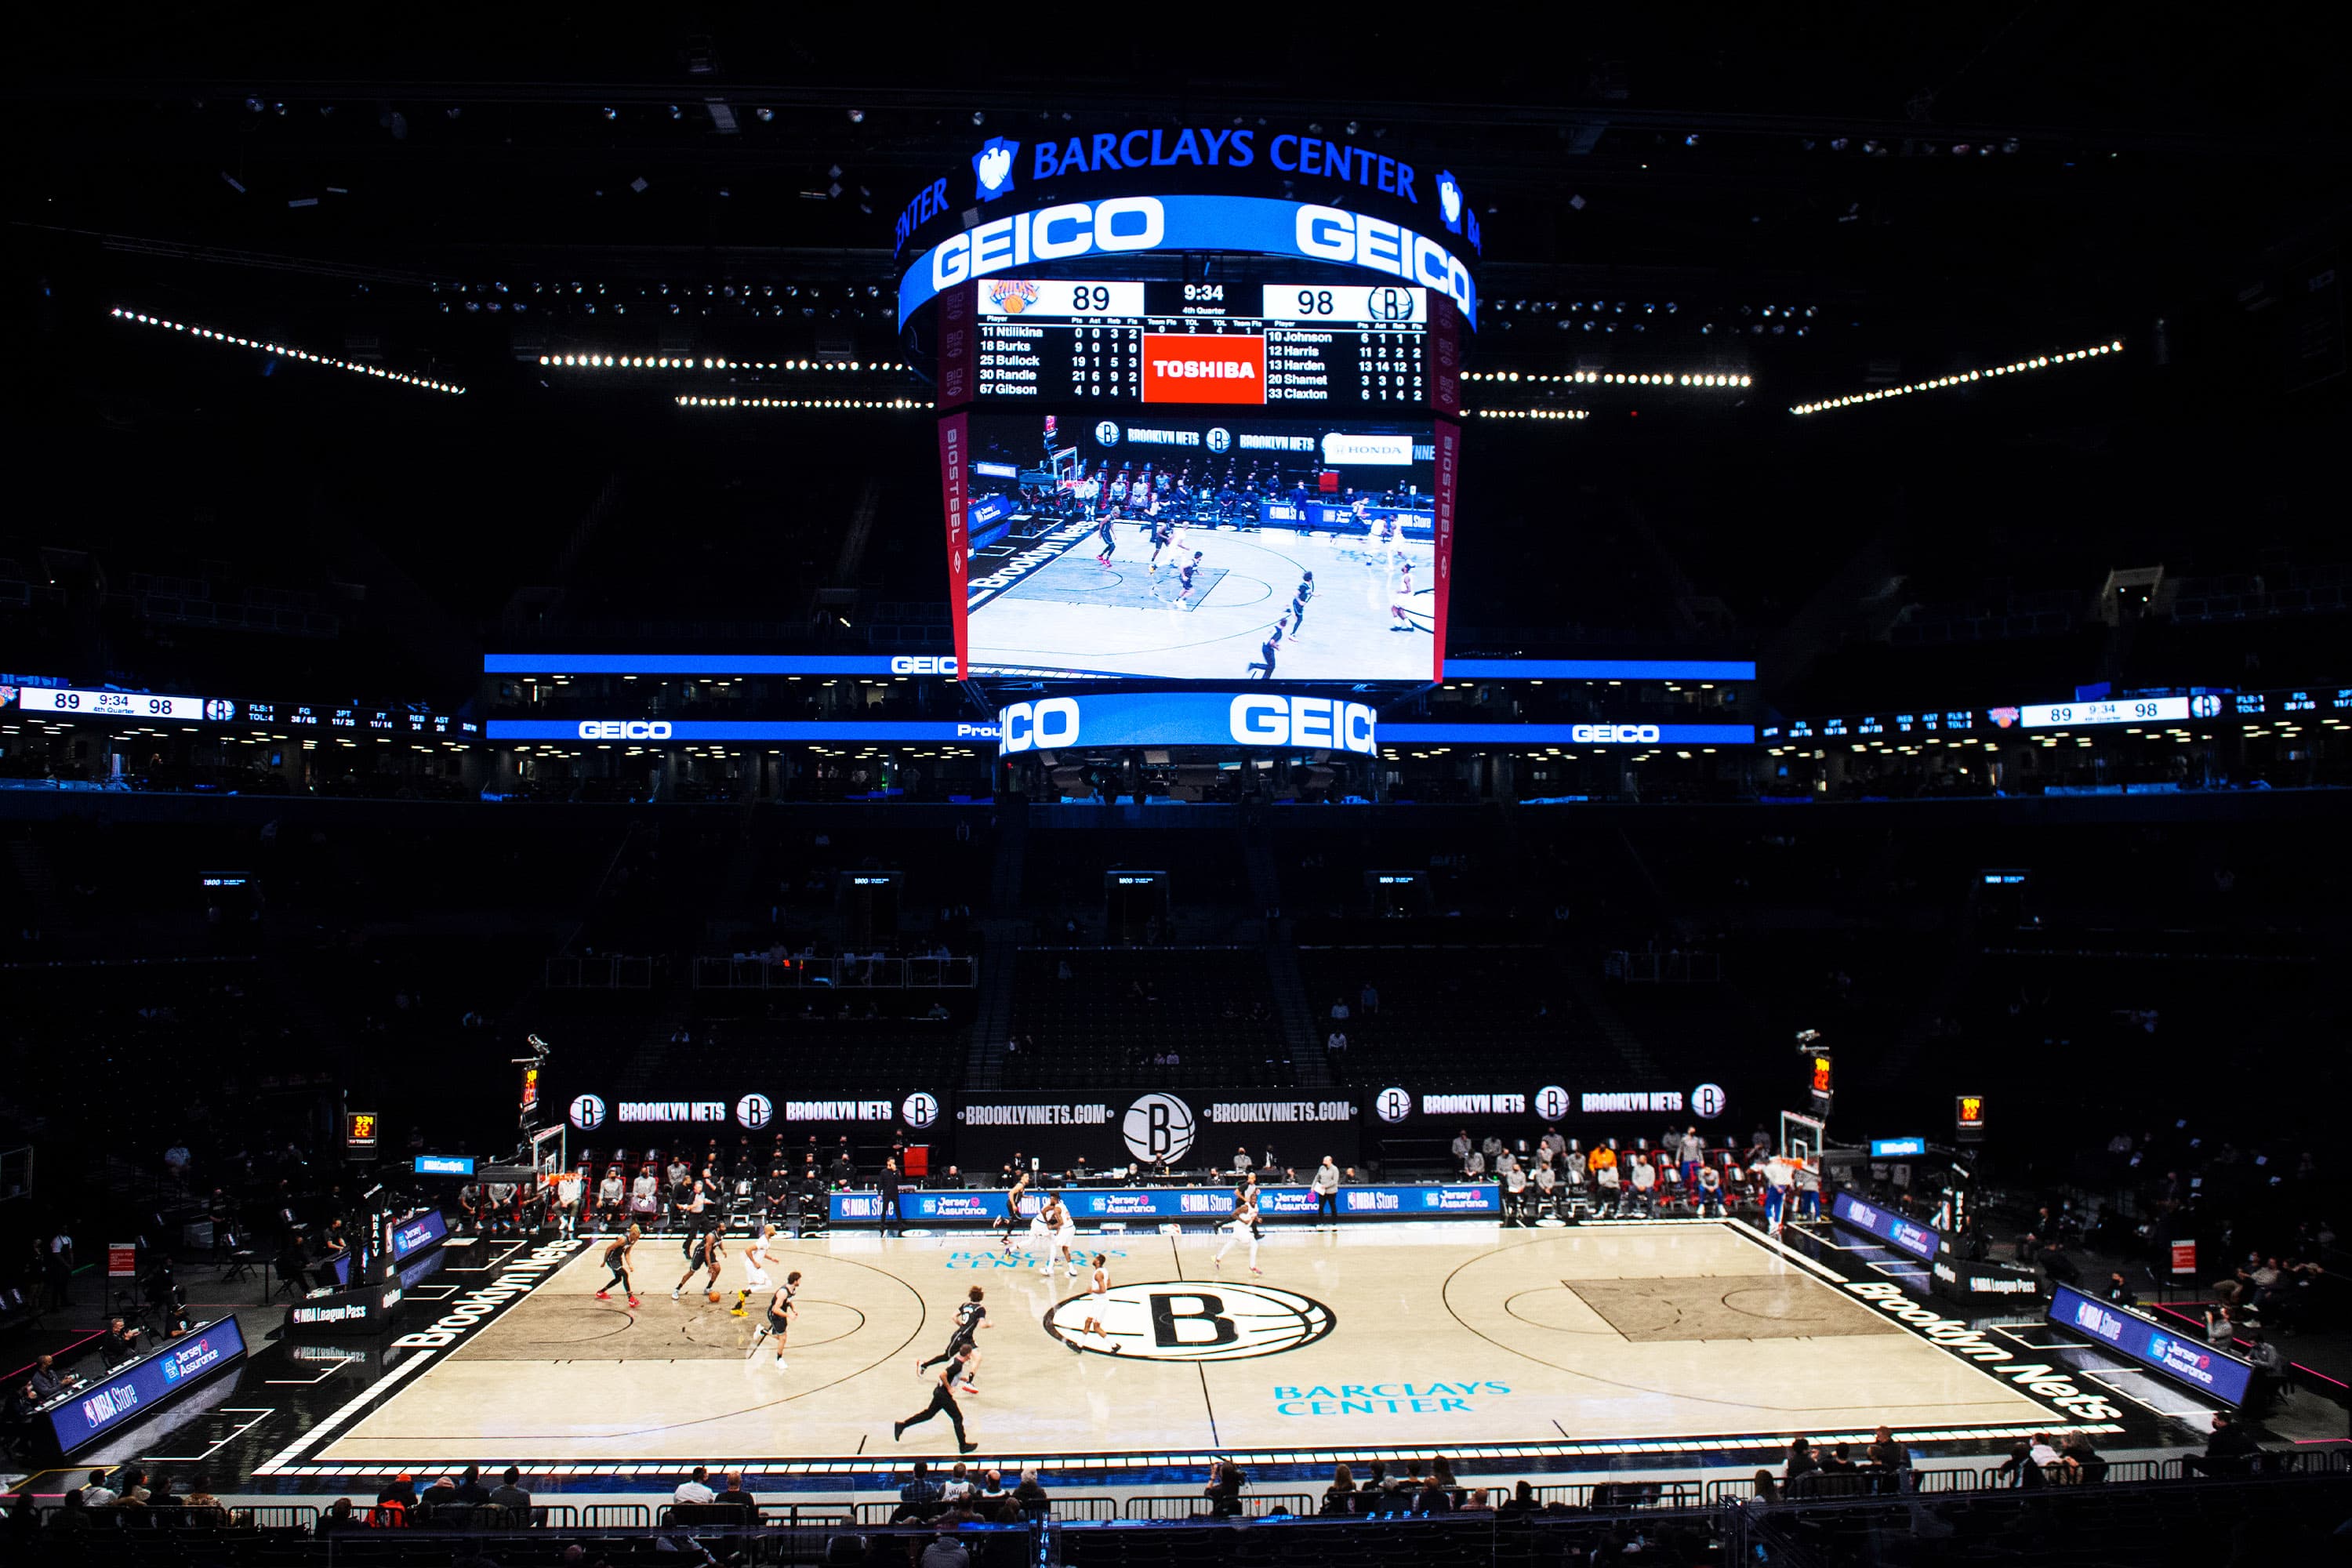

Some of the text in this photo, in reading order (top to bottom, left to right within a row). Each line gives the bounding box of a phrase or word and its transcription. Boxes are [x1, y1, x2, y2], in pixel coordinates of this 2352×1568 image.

[1033, 129, 1417, 203] BARCLAYS CENTER
[894, 177, 949, 260] ENTER
[932, 198, 1165, 292] GEICO
[1295, 205, 1470, 314] GEICO
[1073, 286, 1110, 311] 89
[1185, 285, 1223, 301] 9:34
[1298, 290, 1334, 314] 98
[1196, 307, 1225, 315] Quarter
[982, 327, 1137, 339] 11 Ntilikina 0 0 3 2
[1269, 332, 1421, 343] 10 Johnson 6 1 1 1
[980, 341, 1137, 353] 18 Burks 9 0 1 0
[1269, 346, 1421, 358] 12 Harris 11 2 2 2
[980, 355, 1137, 368] 25 Bullock 19 1 5 3
[1152, 361, 1255, 379] TOSHIBA
[1269, 360, 1421, 372] 13 Harden 13 14 12 1
[980, 370, 1137, 382] 30 Randle 21 6 9 2
[1269, 374, 1421, 387] 20 Shamet 3 3 0 2
[980, 384, 1137, 396] 67 Gibson 4 0 4 1
[1269, 389, 1422, 401] 33 Claxton 6 1 4 2
[1127, 428, 1200, 445] BROOKLYN NETS
[1240, 434, 1315, 452] BROOKLYN NETS
[1348, 445, 1402, 455] HONDA
[947, 429, 961, 543] BIOSTEEL
[1439, 436, 1453, 546] BIOSTEEL
[967, 521, 1099, 588] Brooklyn Nets
[891, 656, 958, 674] GEIC
[54, 693, 79, 709] 89
[100, 695, 129, 706] 9:34
[150, 699, 172, 714] 98
[2051, 708, 2072, 722] 89
[2089, 704, 2115, 715] 9:34
[2135, 703, 2158, 717] 98
[579, 720, 672, 739] GEICO
[1000, 697, 1080, 757] ICO
[1230, 694, 1377, 757] GEICO
[1572, 724, 1660, 742] GEICO
[1423, 1094, 1525, 1115] BROOKLYN NETS
[1582, 1092, 1682, 1112] BROOKLYN NETS
[619, 1102, 725, 1122] BROOKLYN NETS
[786, 1101, 892, 1121] BROOKLYN NETS
[966, 1104, 1105, 1126] BROOKLYNNETS.COM
[1213, 1101, 1350, 1123] BROOKLYNNETS.COM
[938, 1197, 971, 1208] Jersey
[1107, 1195, 1141, 1206] Jersey
[1189, 1194, 1232, 1211] NBA Store
[1274, 1192, 1307, 1203] Jersey
[1356, 1192, 1399, 1209] NBA Store
[1440, 1190, 1472, 1200] Jersey
[851, 1198, 870, 1215] NBA
[937, 1206, 987, 1215] Assurance
[1107, 1204, 1156, 1214] Assurance
[1440, 1200, 1488, 1208] Assurance
[372, 1241, 379, 1257] TV
[391, 1239, 583, 1347] Brooklyn Nets
[2016, 1279, 2035, 1293] Pass
[300, 1305, 366, 1323] NBA League Pass
[176, 1343, 202, 1364] Jersey
[1845, 1282, 2123, 1421] Brooklyn Nets
[2167, 1341, 2201, 1366] Jersey
[180, 1348, 219, 1377] Assurance
[2163, 1353, 2213, 1385] Assurance
[1274, 1381, 1512, 1400] BARCLAYS
[91, 1385, 138, 1423] NBA Store
[1276, 1398, 1475, 1417] CENTER
